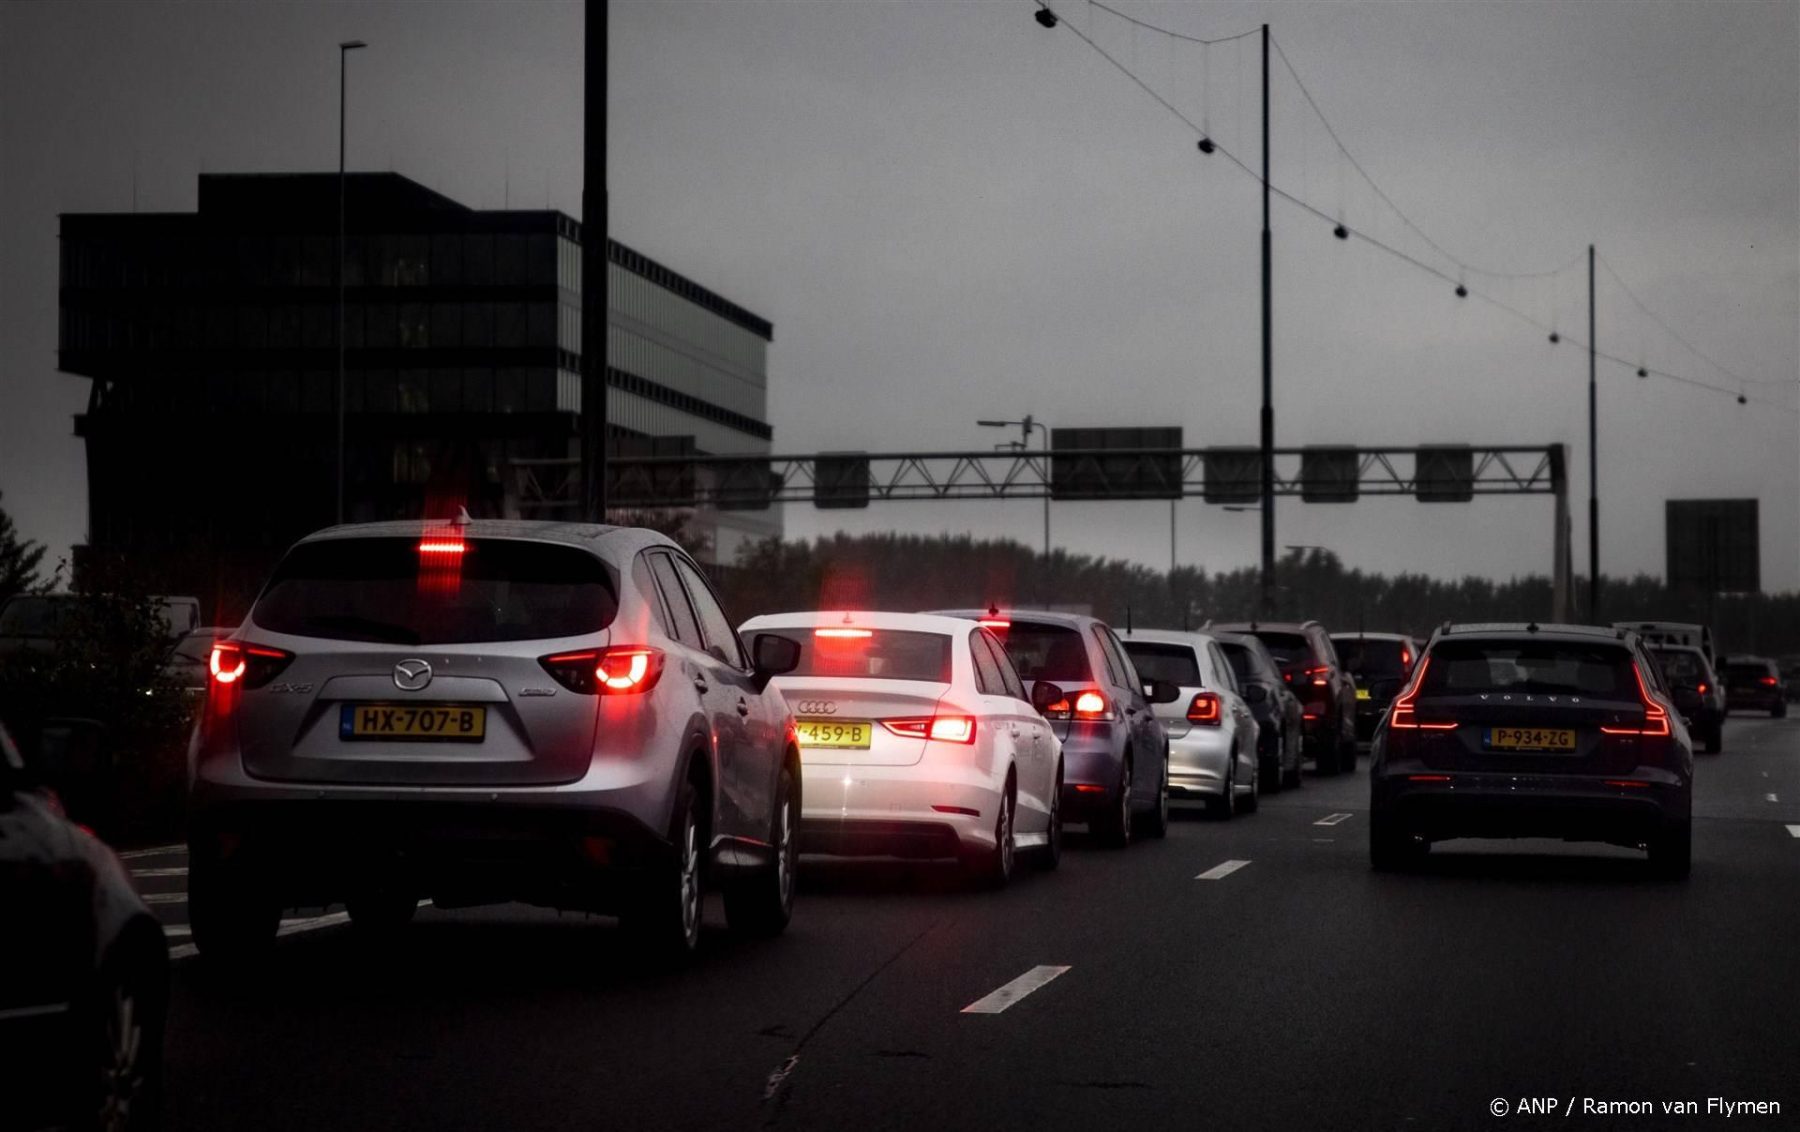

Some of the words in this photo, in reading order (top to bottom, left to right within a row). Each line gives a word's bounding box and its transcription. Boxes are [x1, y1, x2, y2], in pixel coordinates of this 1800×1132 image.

[1480, 694, 1580, 703] VOLVO
[363, 709, 474, 732] HX-707-B
[1498, 730, 1569, 746] P-934-ZG
